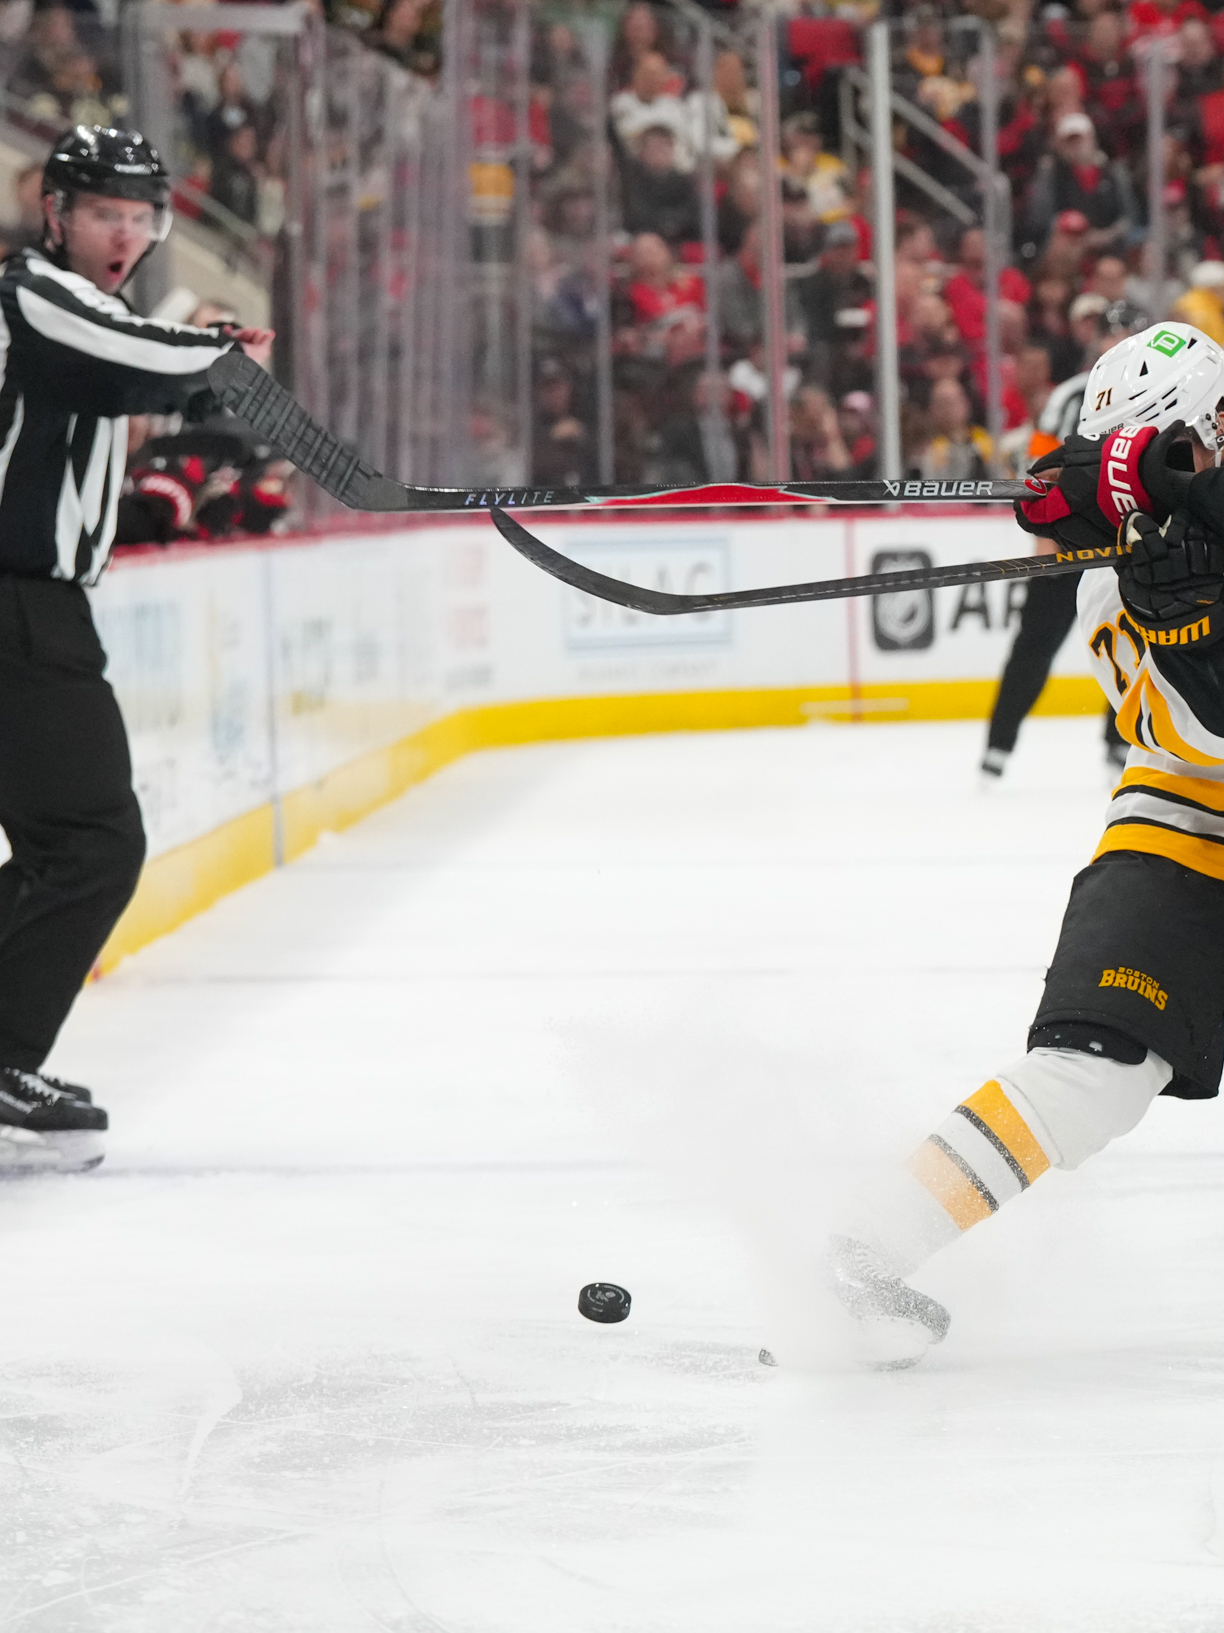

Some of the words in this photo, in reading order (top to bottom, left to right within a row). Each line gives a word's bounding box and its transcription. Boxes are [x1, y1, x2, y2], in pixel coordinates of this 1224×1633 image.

[1095, 387, 1113, 411] 71
[1107, 425, 1139, 521] BAUE
[464, 491, 554, 506] FLYLITE
[903, 480, 994, 497] BAUER
[1126, 610, 1211, 646] WAR
[1099, 969, 1168, 1010] BRUINS
[1118, 967, 1159, 989] BOSTON
